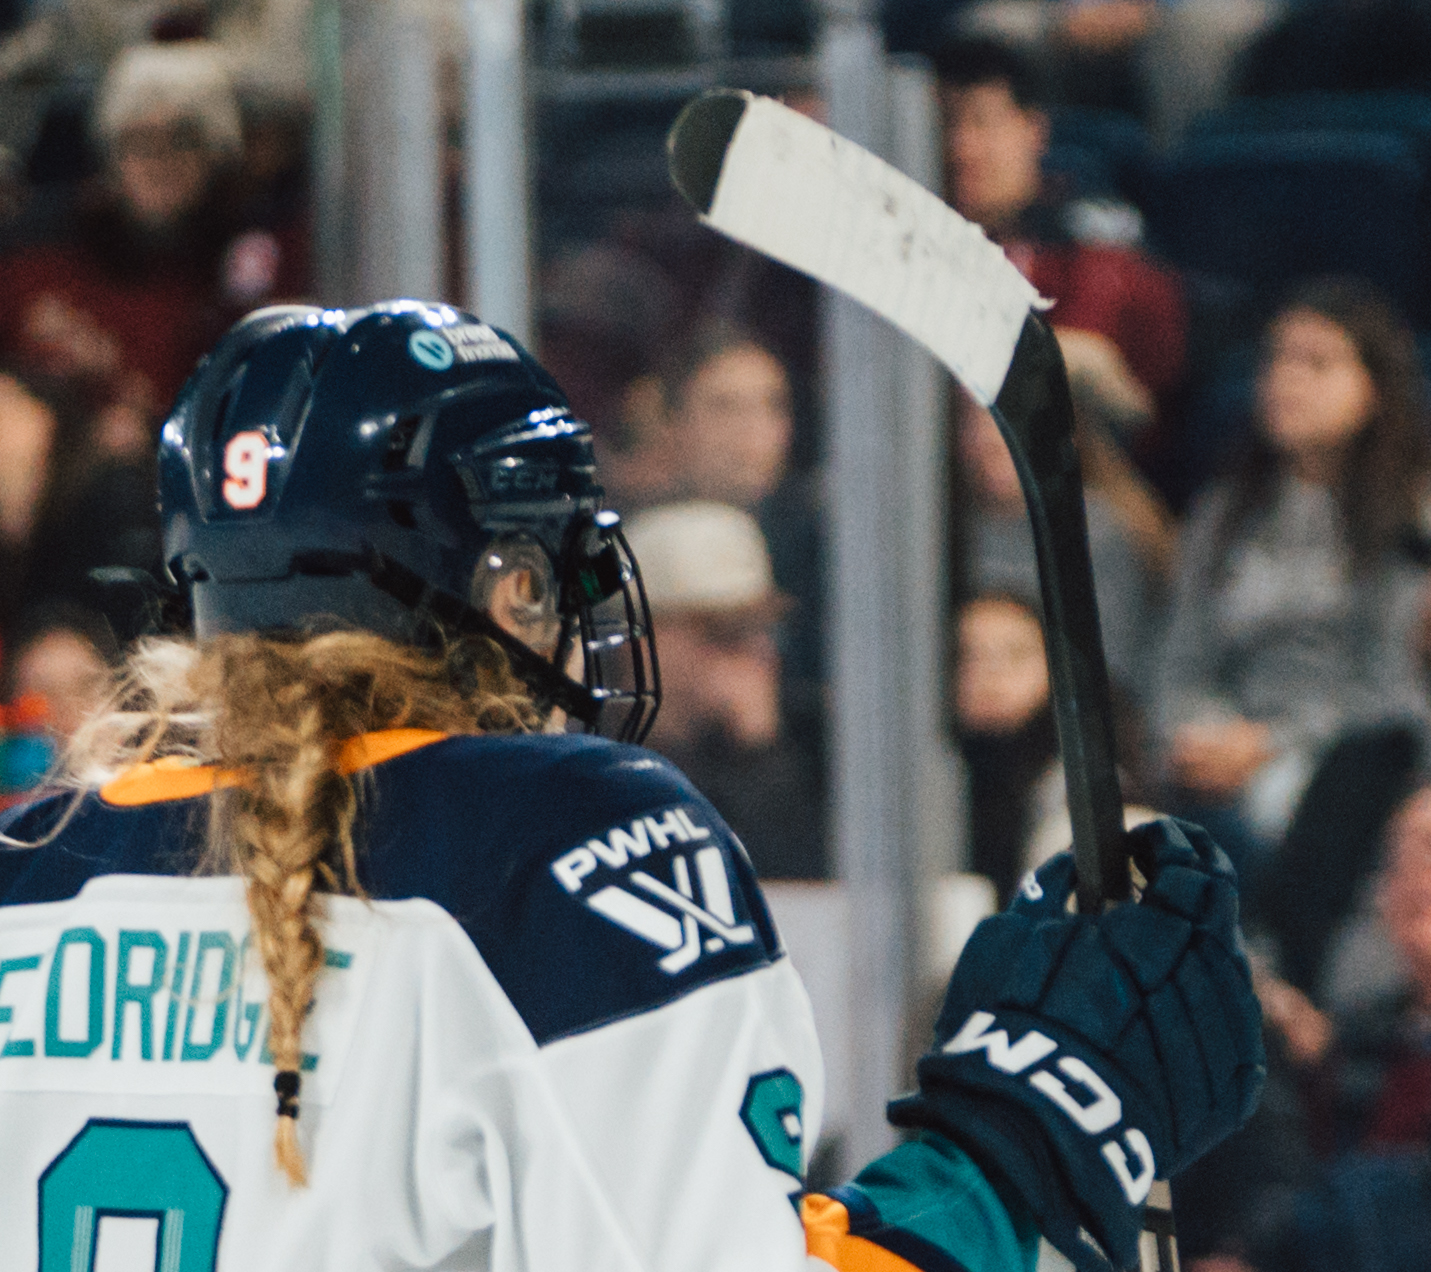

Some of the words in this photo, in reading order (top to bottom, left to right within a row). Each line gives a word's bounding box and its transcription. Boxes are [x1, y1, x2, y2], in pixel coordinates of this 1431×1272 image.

[223, 430, 268, 511] 9
[551, 809, 710, 893] PWHL
[942, 1011, 1156, 1206] CCM
